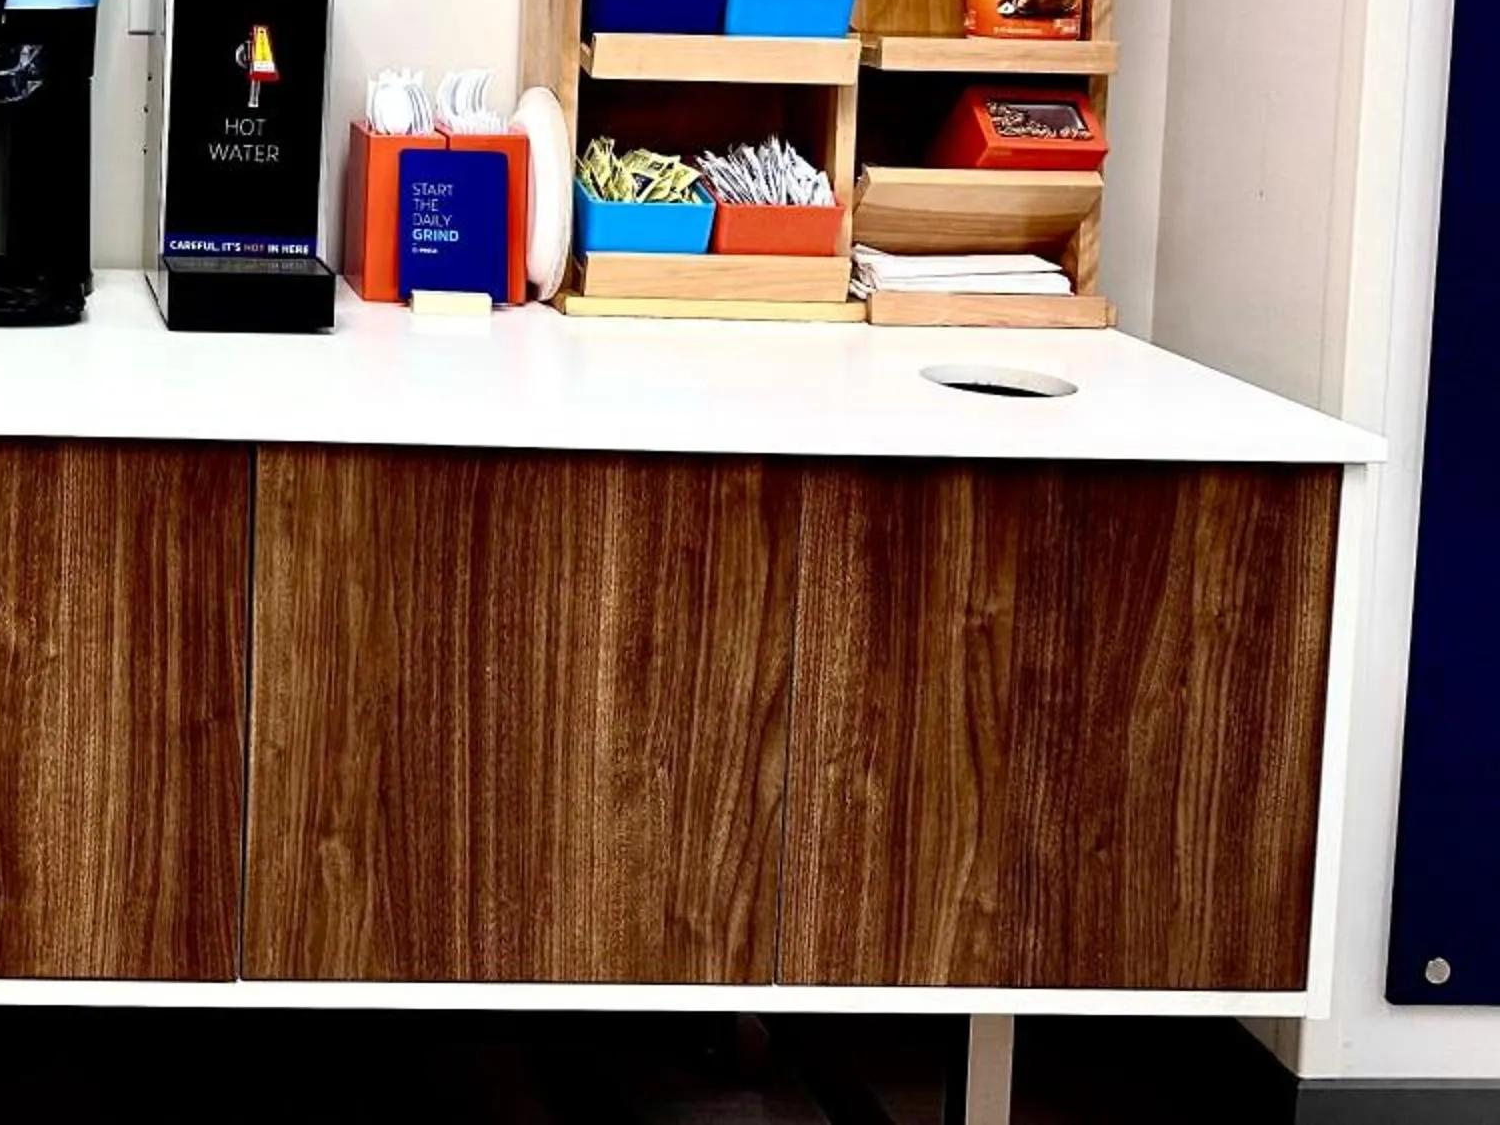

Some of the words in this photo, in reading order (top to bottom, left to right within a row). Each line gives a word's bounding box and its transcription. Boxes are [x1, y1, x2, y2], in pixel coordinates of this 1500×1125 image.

[225, 117, 268, 136] HOT
[208, 143, 280, 162] WATER
[412, 182, 454, 196] START
[412, 198, 439, 212] THE
[412, 212, 453, 227] DAILY
[412, 228, 459, 242] GRIND
[221, 242, 241, 252] IT'S
[267, 244, 279, 254] IN
[281, 244, 309, 255] HERE
